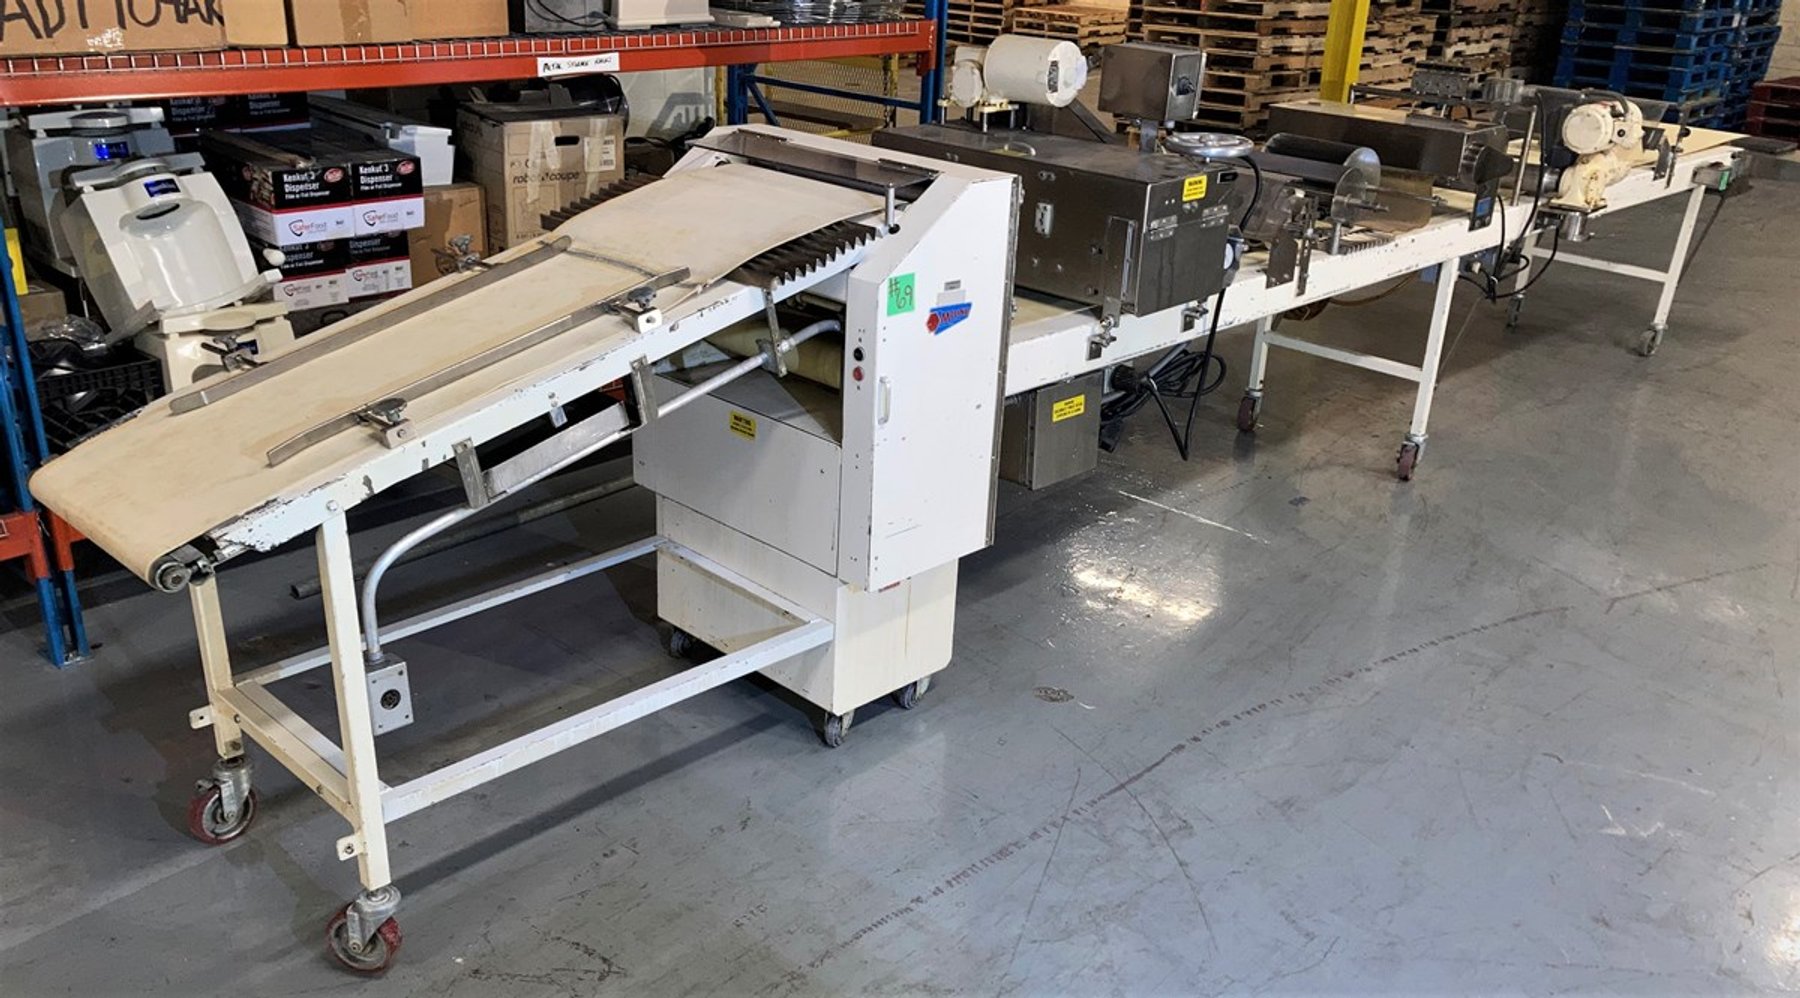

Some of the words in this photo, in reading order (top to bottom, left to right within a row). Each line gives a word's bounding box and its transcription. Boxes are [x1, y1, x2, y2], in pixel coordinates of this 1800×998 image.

[359, 164, 383, 174] Kenkut
[384, 163, 389, 172] 3
[283, 172, 308, 182] Kenkut
[360, 174, 393, 184] Dispenser
[549, 171, 580, 182] coupe
[284, 182, 320, 193] Dispenser
[887, 277, 913, 309] #69
